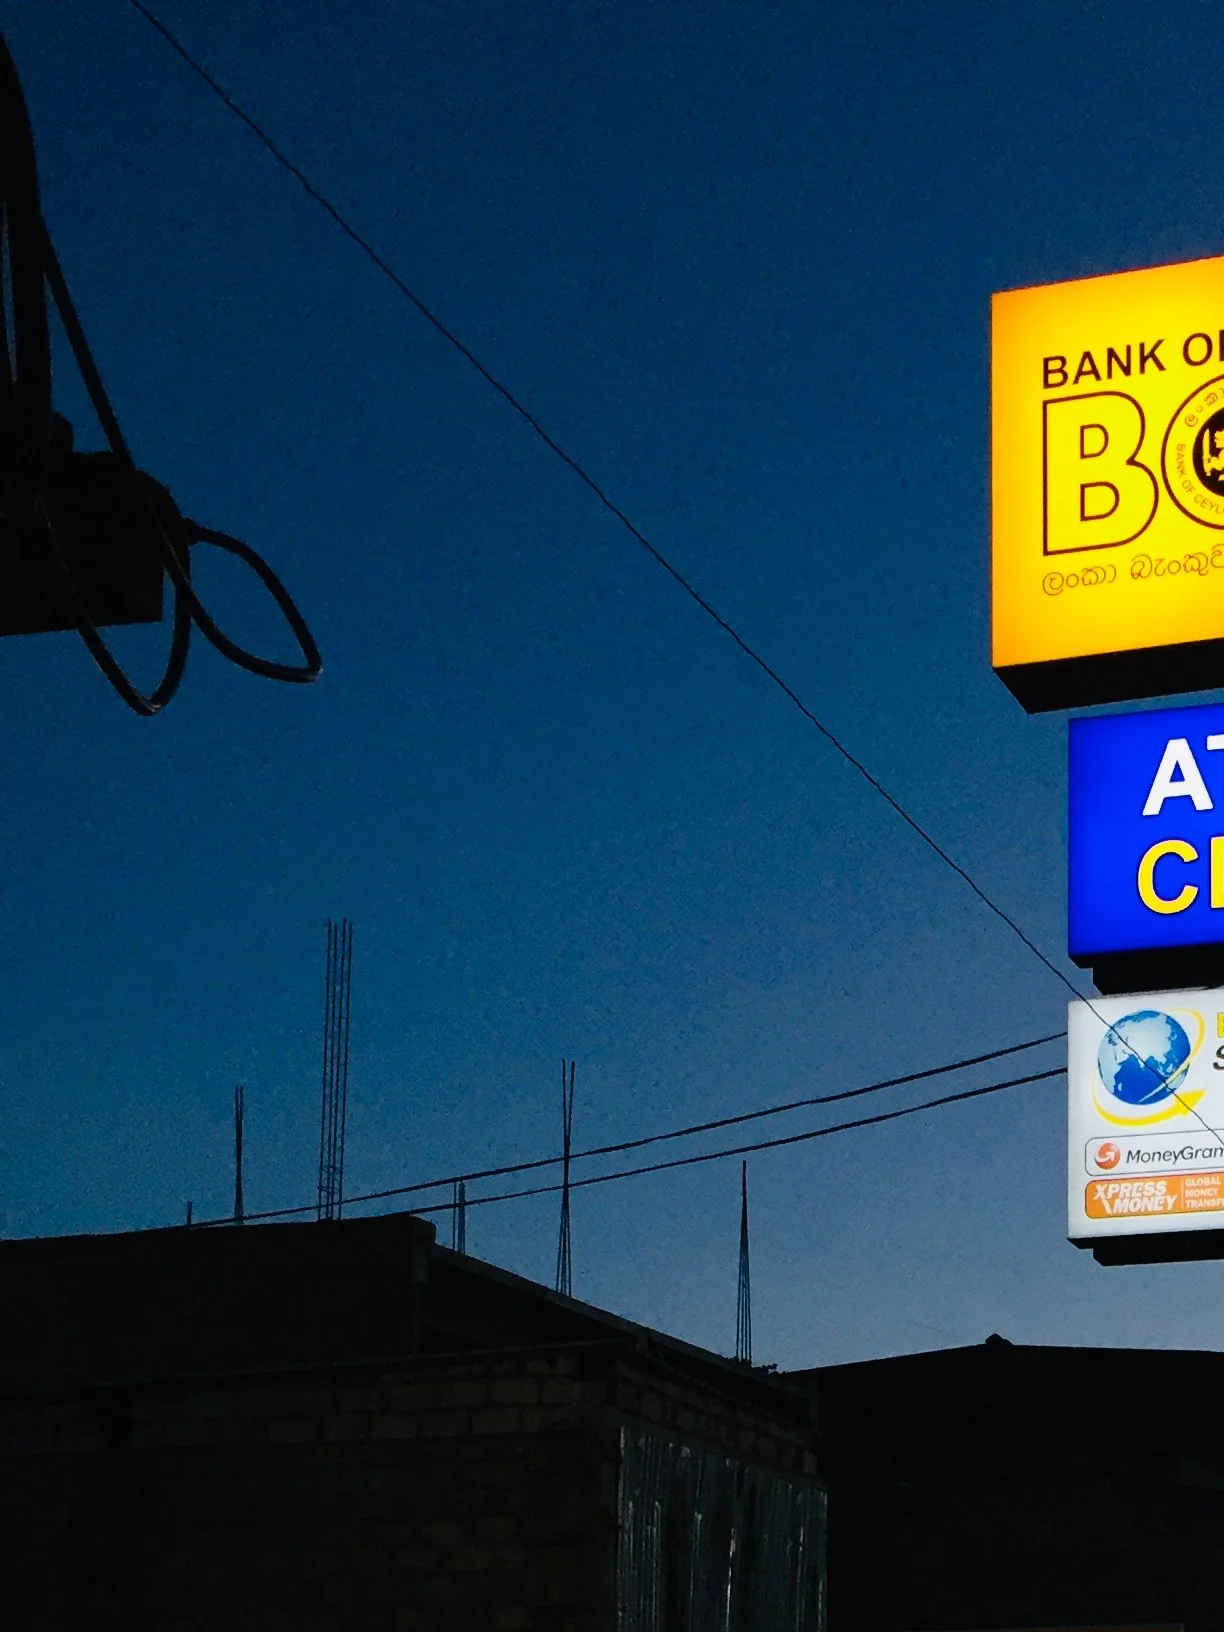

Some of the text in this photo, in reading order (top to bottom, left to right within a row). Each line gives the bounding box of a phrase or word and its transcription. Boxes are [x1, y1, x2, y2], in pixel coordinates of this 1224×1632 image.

[1042, 339, 1167, 389] BANK
[1175, 443, 1188, 478] BANK
[1182, 480, 1197, 494] OF
[1041, 564, 1117, 597] ලංකා
[1093, 1180, 1168, 1201] XPRESS
[1184, 1176, 1222, 1187] GLOBAL
[1184, 1188, 1220, 1198] MONEY
[1110, 1195, 1178, 1215] MONEY
